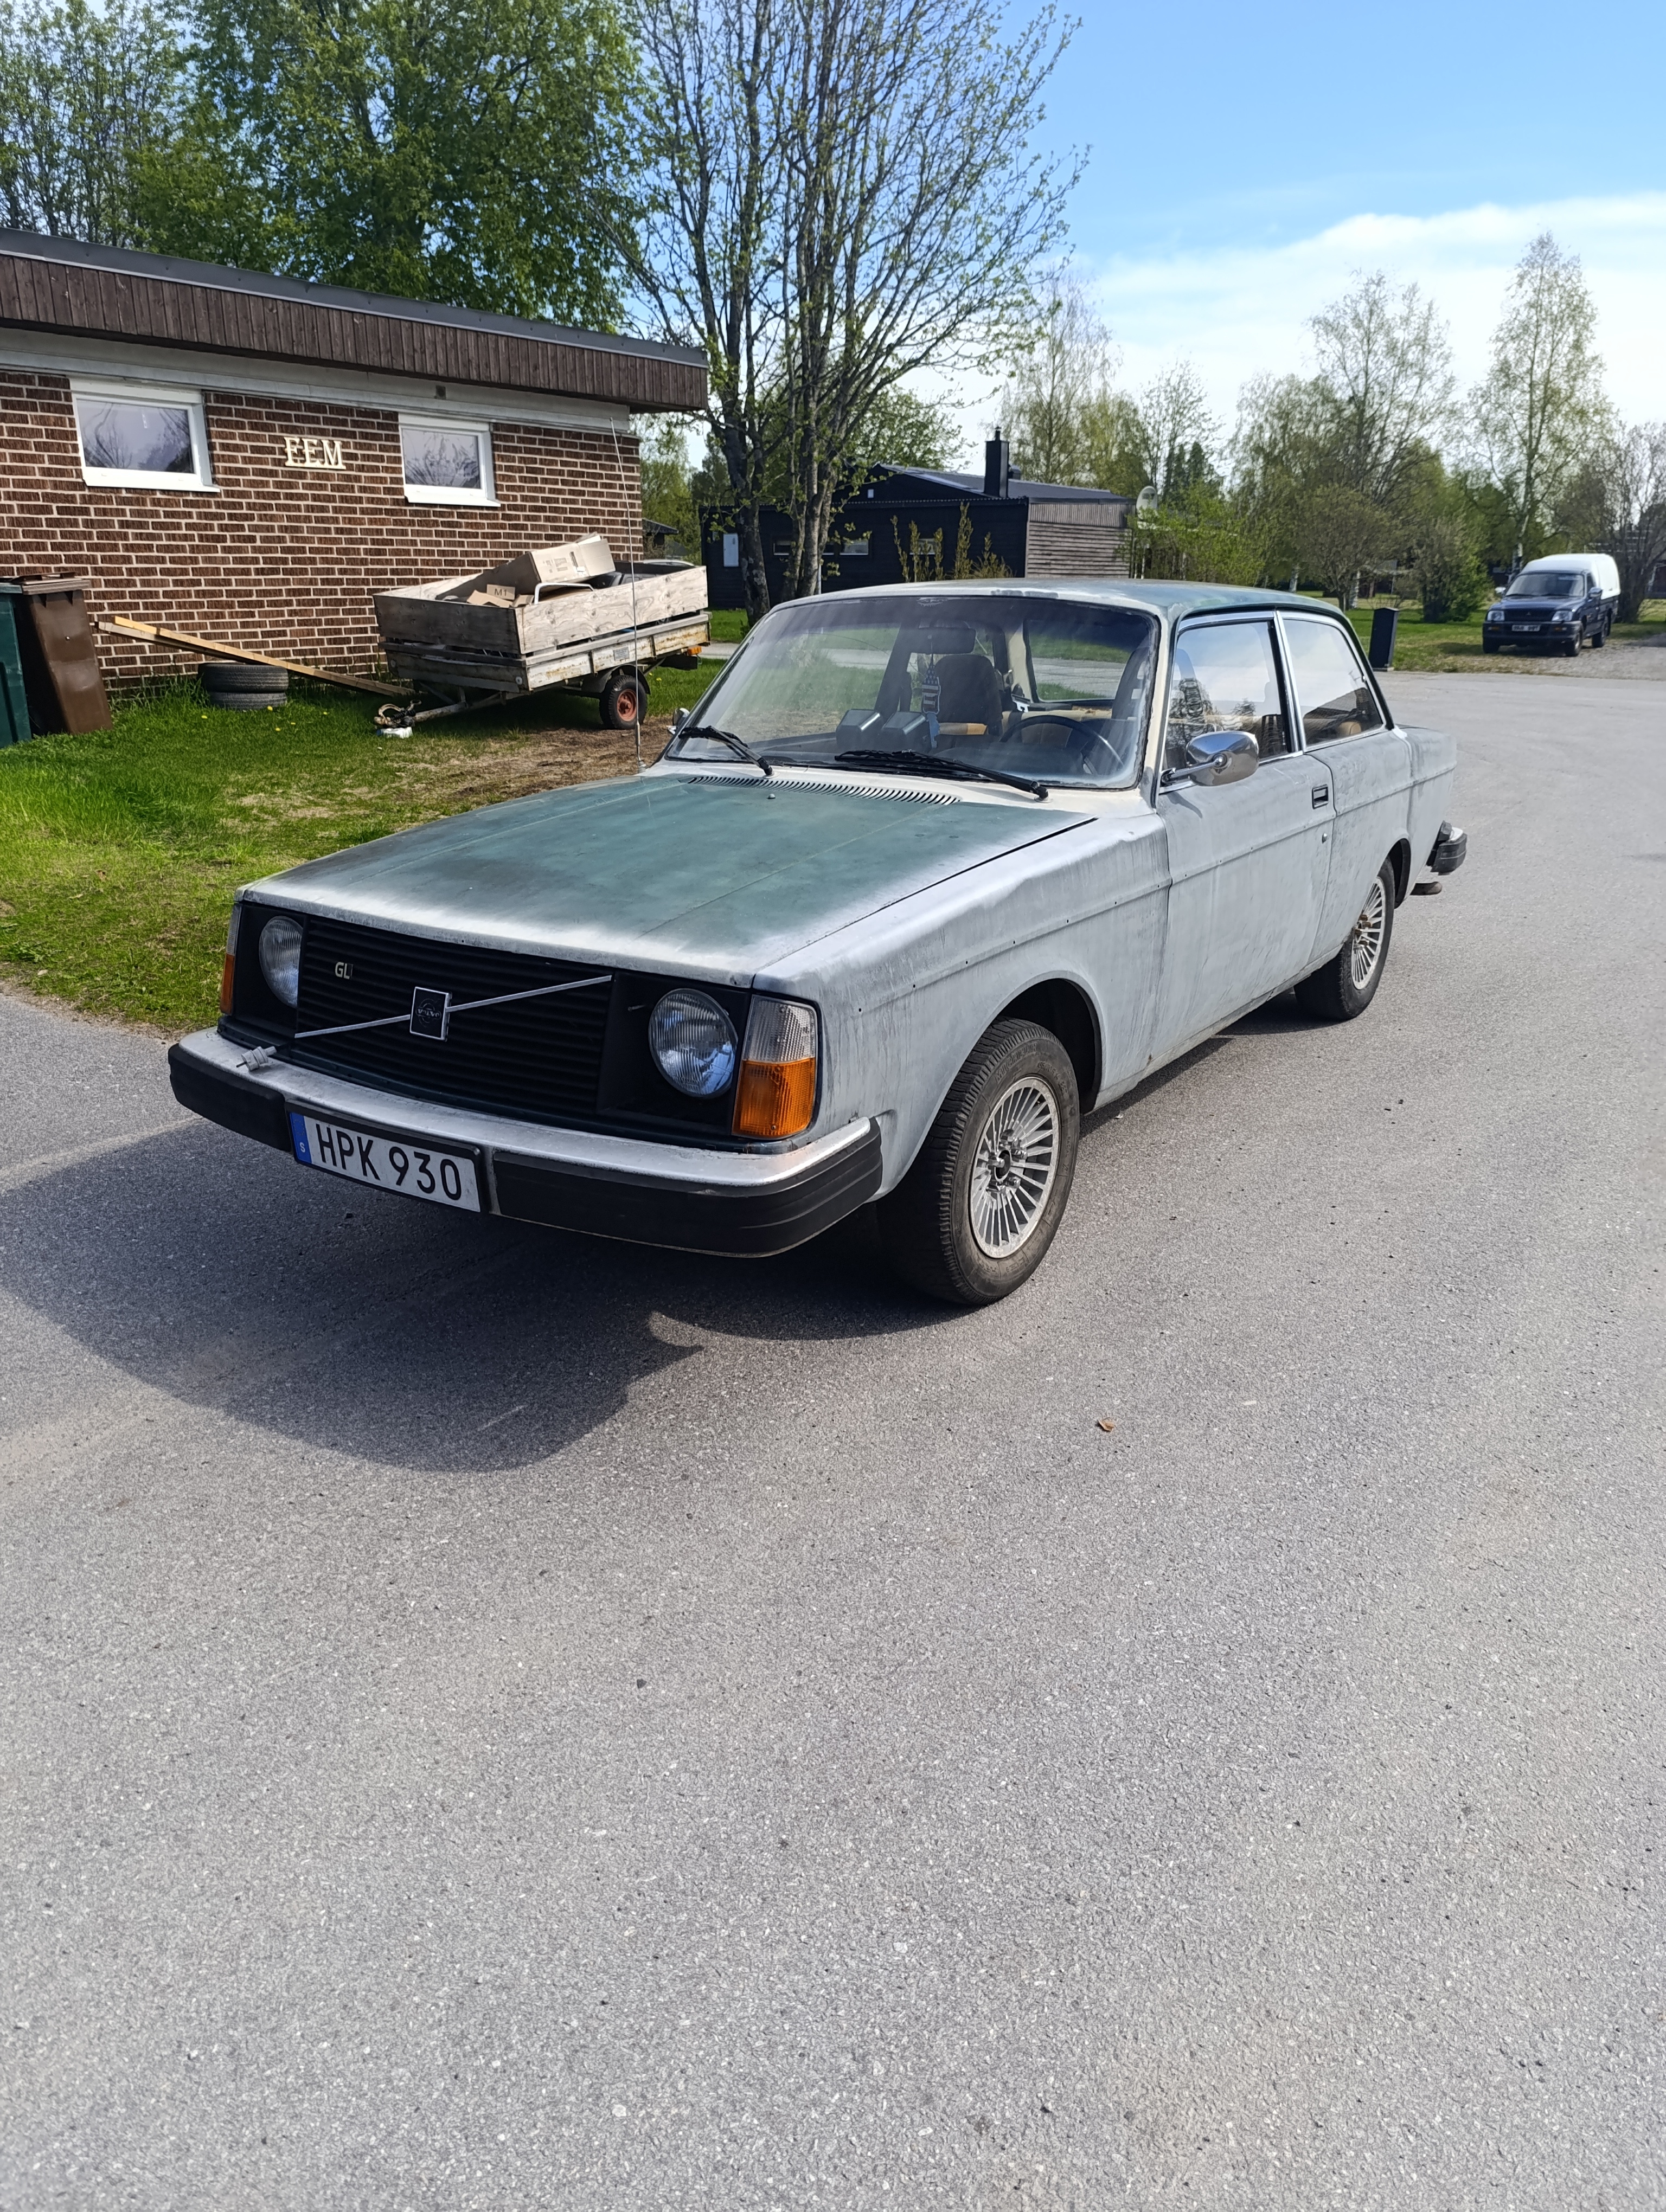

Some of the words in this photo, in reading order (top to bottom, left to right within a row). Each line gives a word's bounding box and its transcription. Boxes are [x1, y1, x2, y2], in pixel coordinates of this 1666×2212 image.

[335, 962, 350, 979] GL
[300, 1142, 305, 1153] S
[316, 1123, 381, 1181] HPK
[389, 1146, 462, 1200] 930
